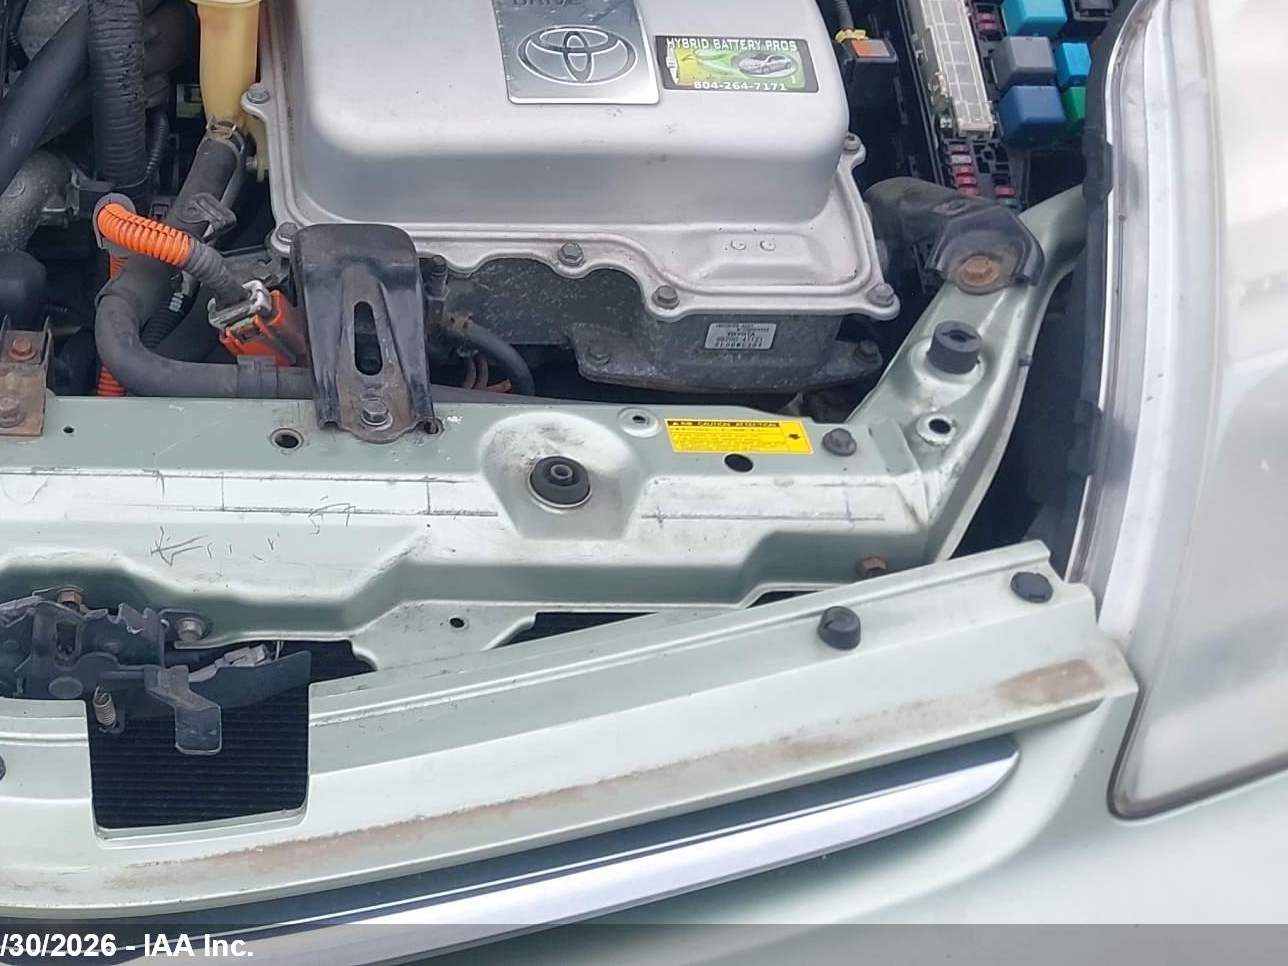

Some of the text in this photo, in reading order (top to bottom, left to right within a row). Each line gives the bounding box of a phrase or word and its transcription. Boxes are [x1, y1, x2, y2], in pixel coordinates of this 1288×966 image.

[666, 37, 798, 51] HYBRID BATTERY PROS
